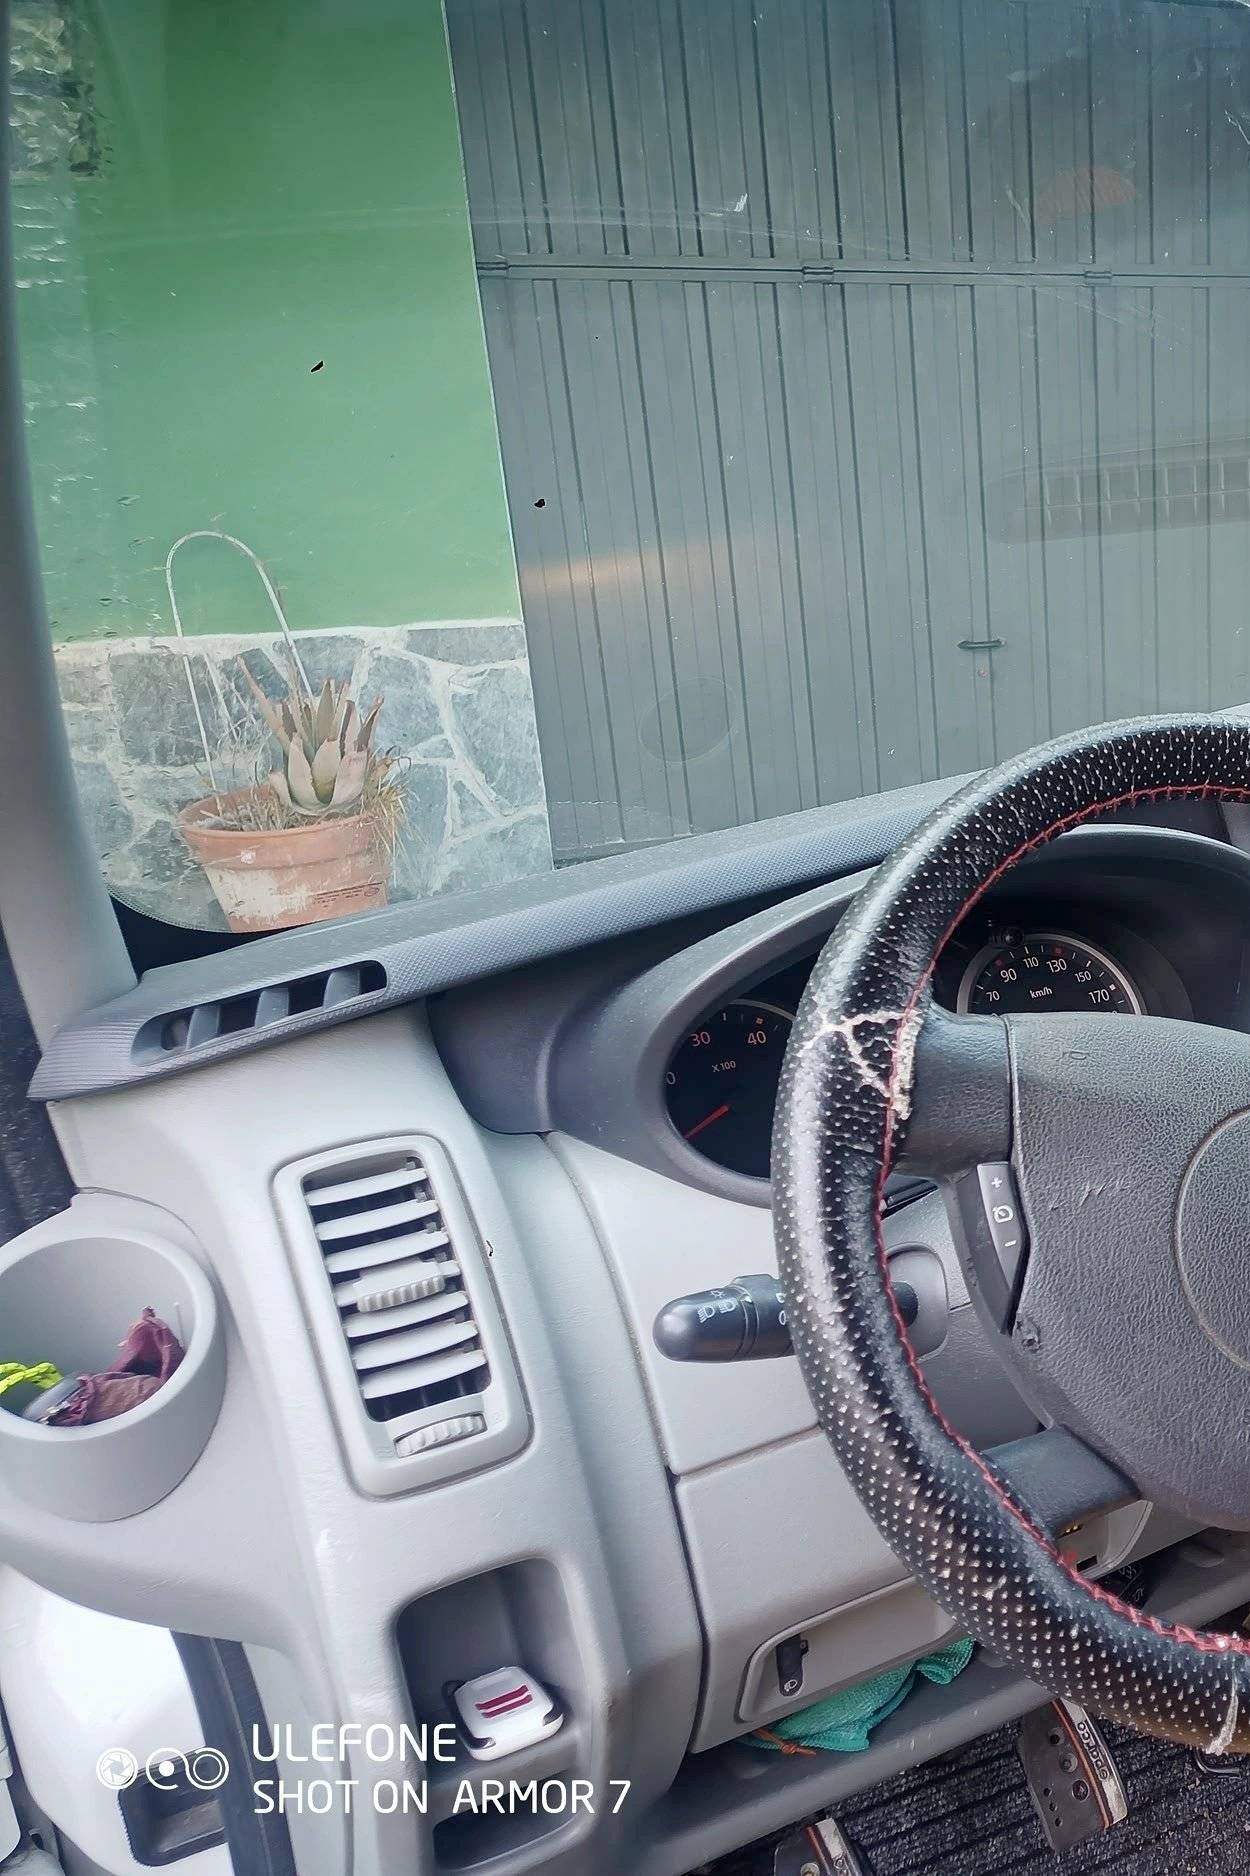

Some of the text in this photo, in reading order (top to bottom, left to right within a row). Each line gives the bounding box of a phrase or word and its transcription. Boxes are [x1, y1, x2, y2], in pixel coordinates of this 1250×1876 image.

[1023, 957, 1039, 969] 110
[1046, 958, 1067, 973] 130
[1000, 968, 1017, 983] 90
[1075, 971, 1091, 983] 150
[986, 990, 1000, 1002] 70
[1029, 986, 1053, 999] km/h
[1088, 988, 1110, 1004] 170
[690, 1031, 711, 1047] 30
[747, 1030, 767, 1045] 40
